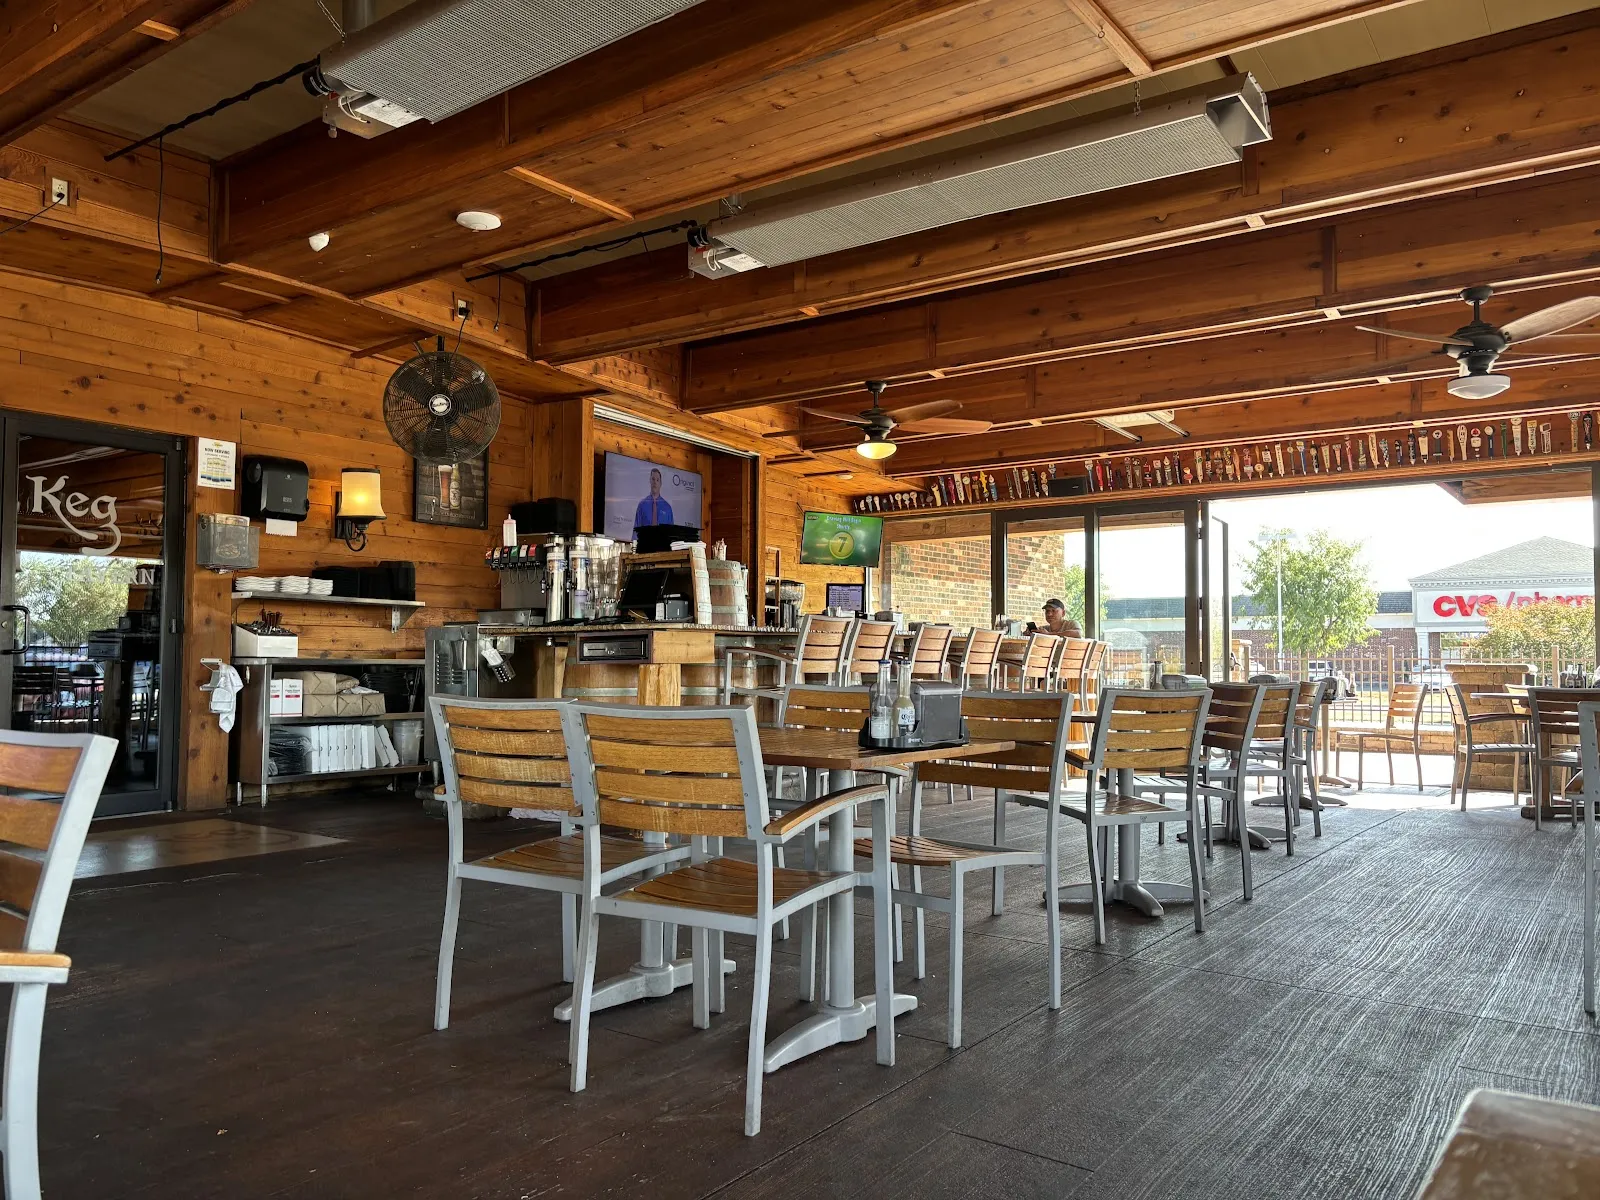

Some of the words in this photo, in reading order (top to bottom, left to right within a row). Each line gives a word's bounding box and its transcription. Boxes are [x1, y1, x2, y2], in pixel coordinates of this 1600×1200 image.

[25, 474, 122, 557] Keg
[838, 536, 847, 553] 7
[1433, 594, 1498, 617] CVS
